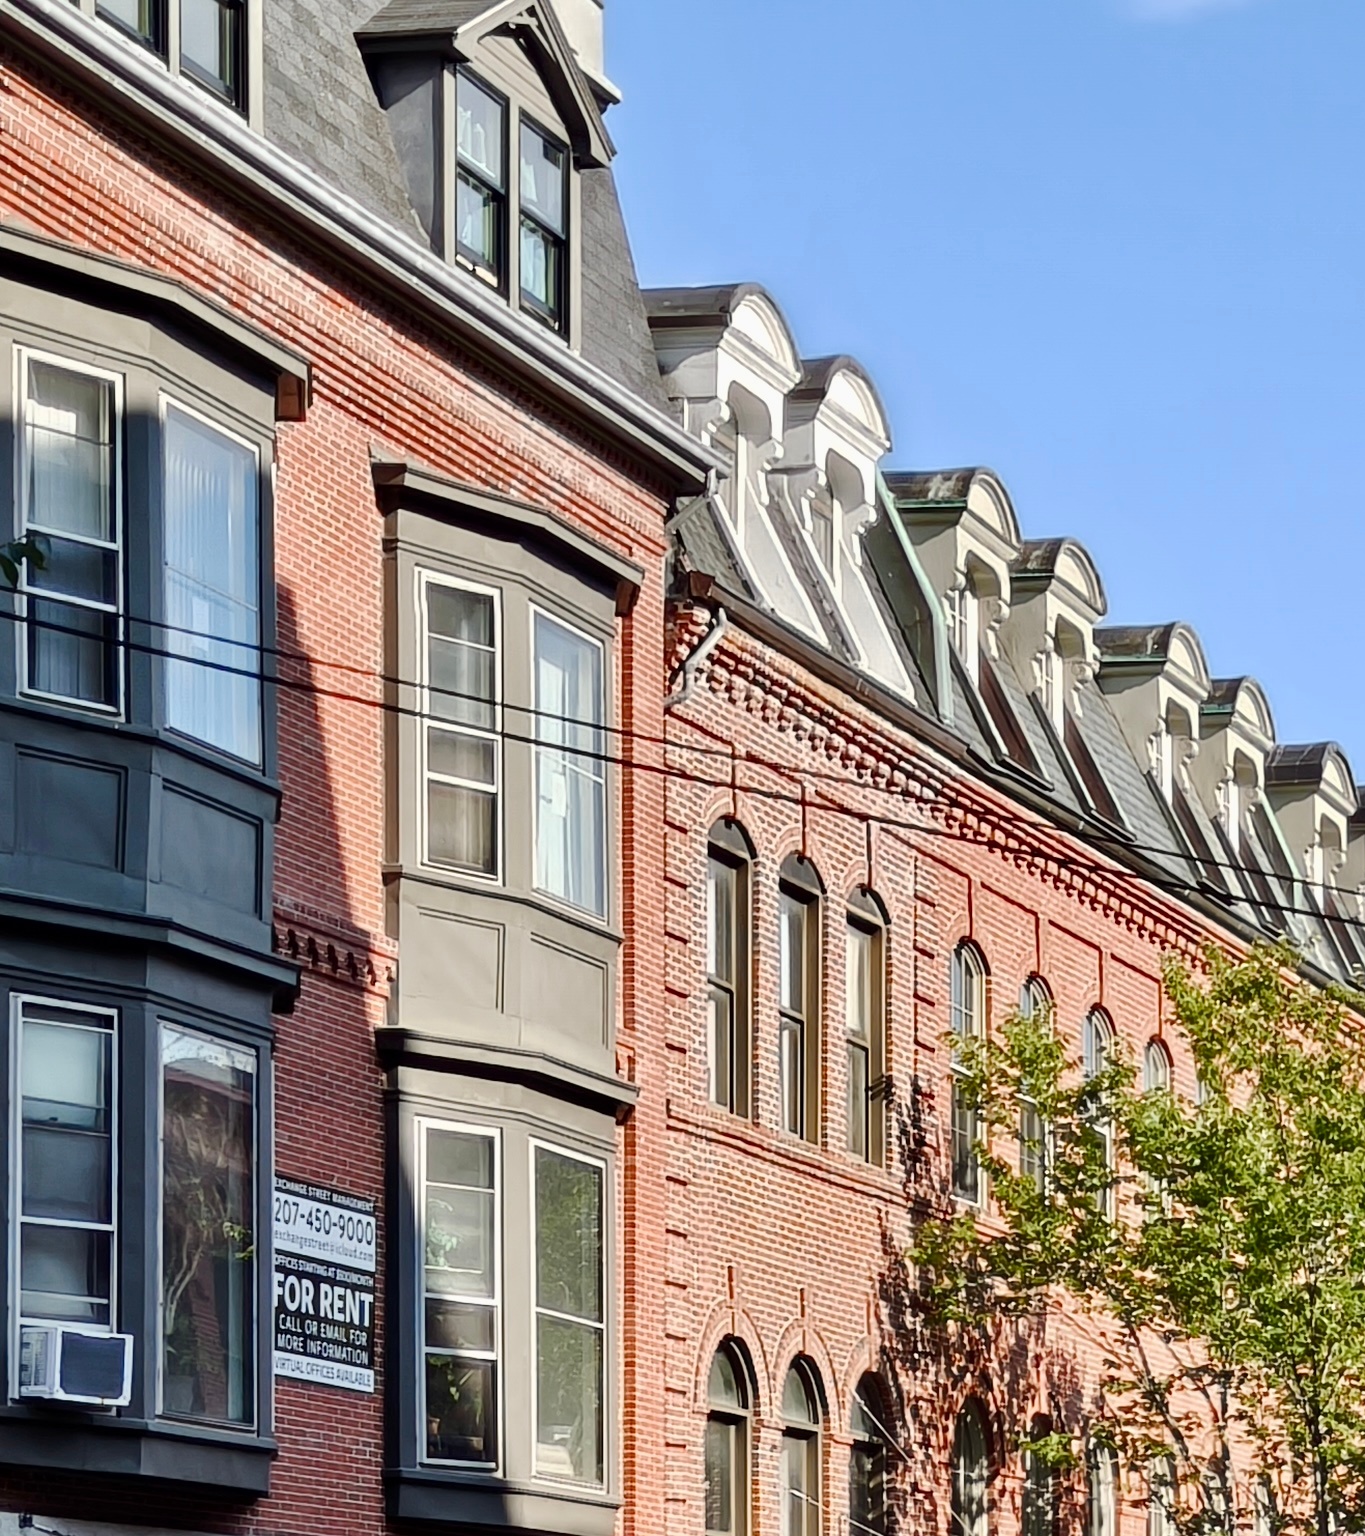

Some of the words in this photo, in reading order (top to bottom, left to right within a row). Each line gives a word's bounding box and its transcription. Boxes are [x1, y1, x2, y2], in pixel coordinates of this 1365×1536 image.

[274, 1196, 374, 1246] 207-450-9000
[274, 1272, 315, 1315] FOR
[320, 1282, 373, 1328] RENT
[279, 1313, 303, 1333] CALL
[304, 1319, 318, 1336] OR
[320, 1323, 347, 1342] EMAIL
[349, 1329, 368, 1346] FOR
[277, 1333, 304, 1352] MORE
[307, 1339, 369, 1365] INFORMATION
[275, 1355, 304, 1374] VIRTUAL
[306, 1362, 334, 1379] OFFICES
[336, 1368, 371, 1387] AVAILABLE
